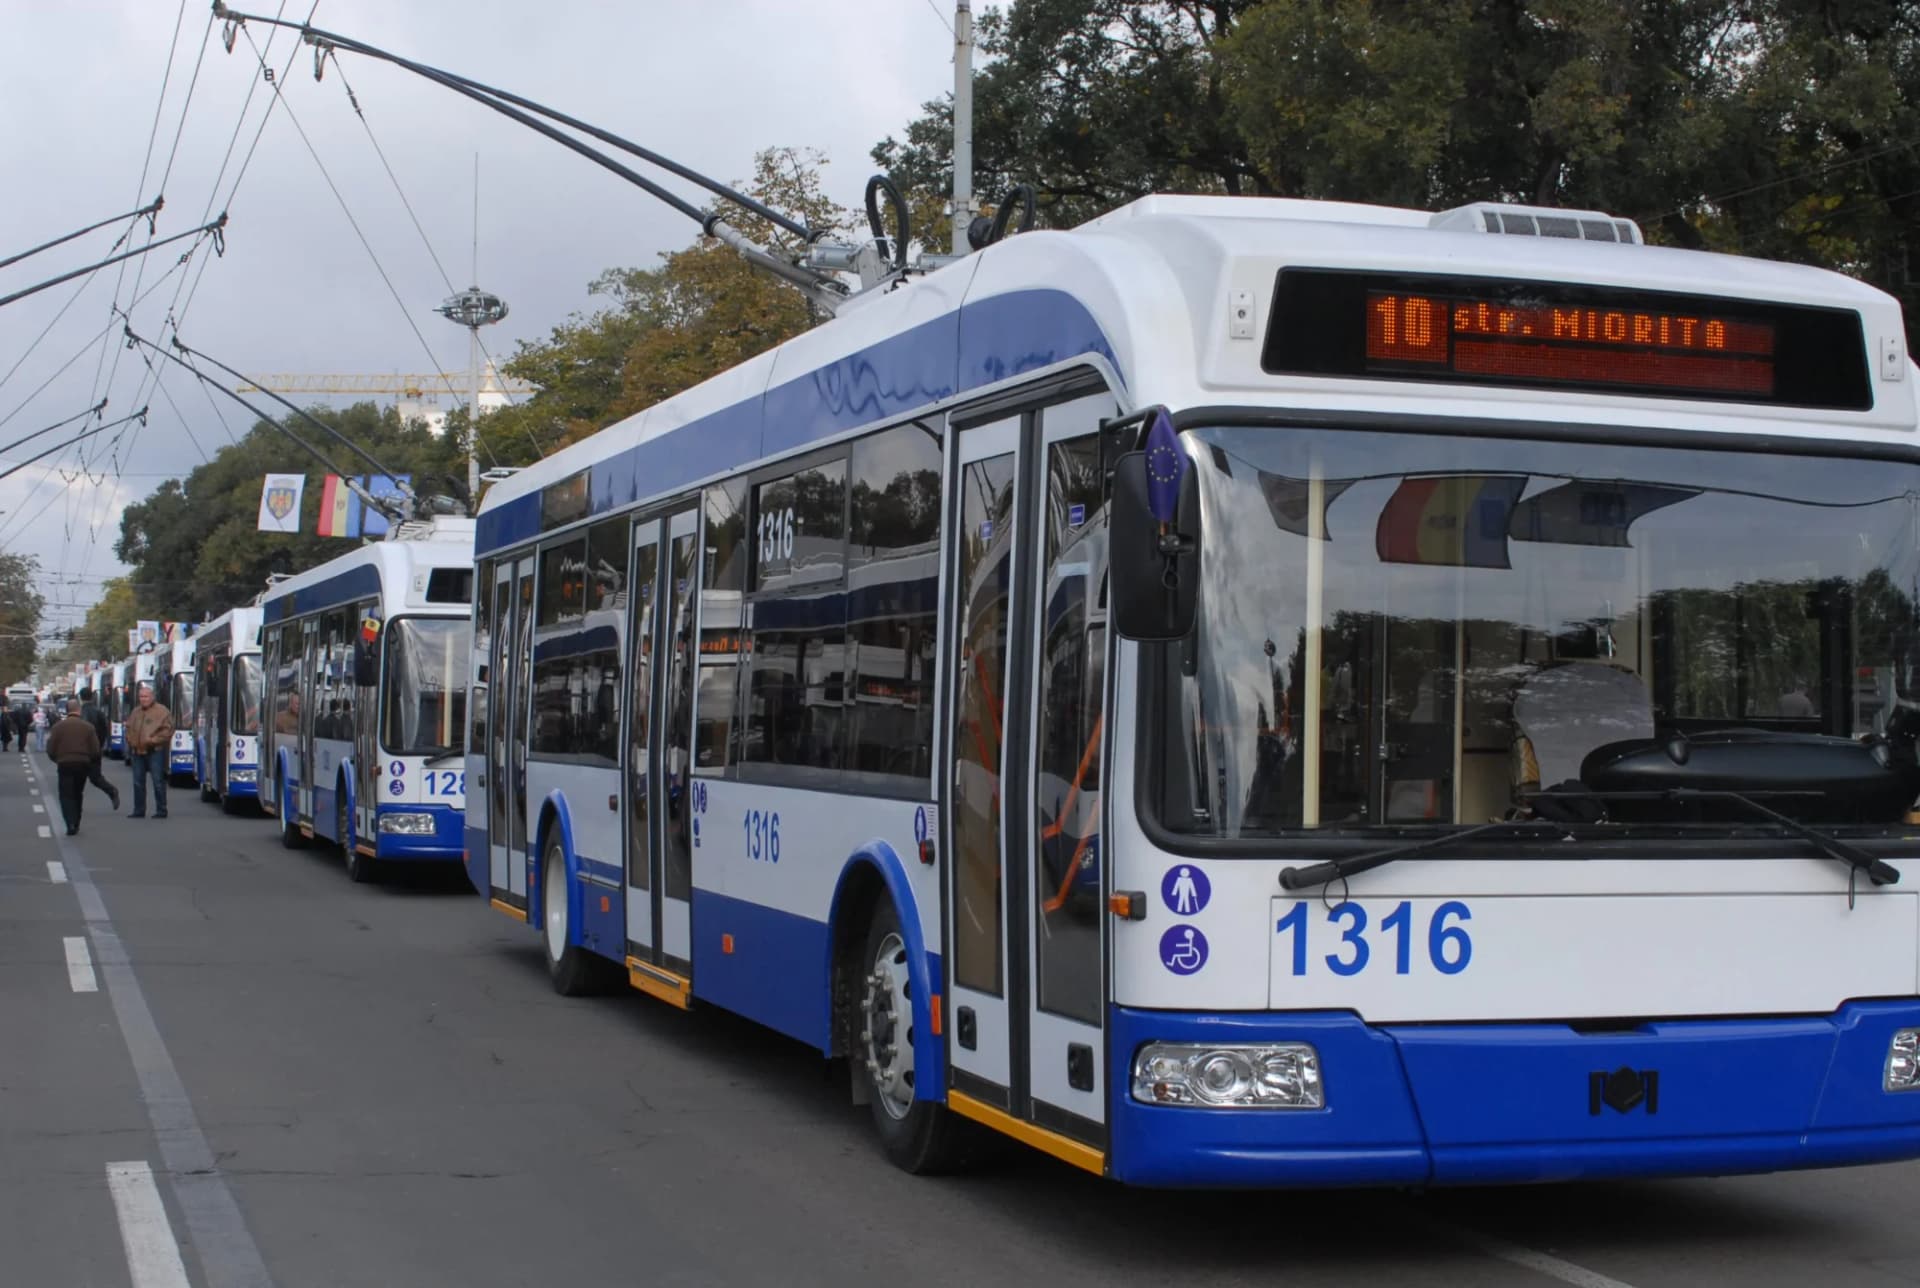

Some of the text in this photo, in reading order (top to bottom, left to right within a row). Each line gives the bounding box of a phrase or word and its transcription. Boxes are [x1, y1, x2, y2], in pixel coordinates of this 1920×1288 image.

[1376, 296, 1724, 348] 10 str. MIORITA
[757, 507, 794, 563] 1316
[743, 808, 780, 865] 1316
[1276, 900, 1473, 976] 1316
